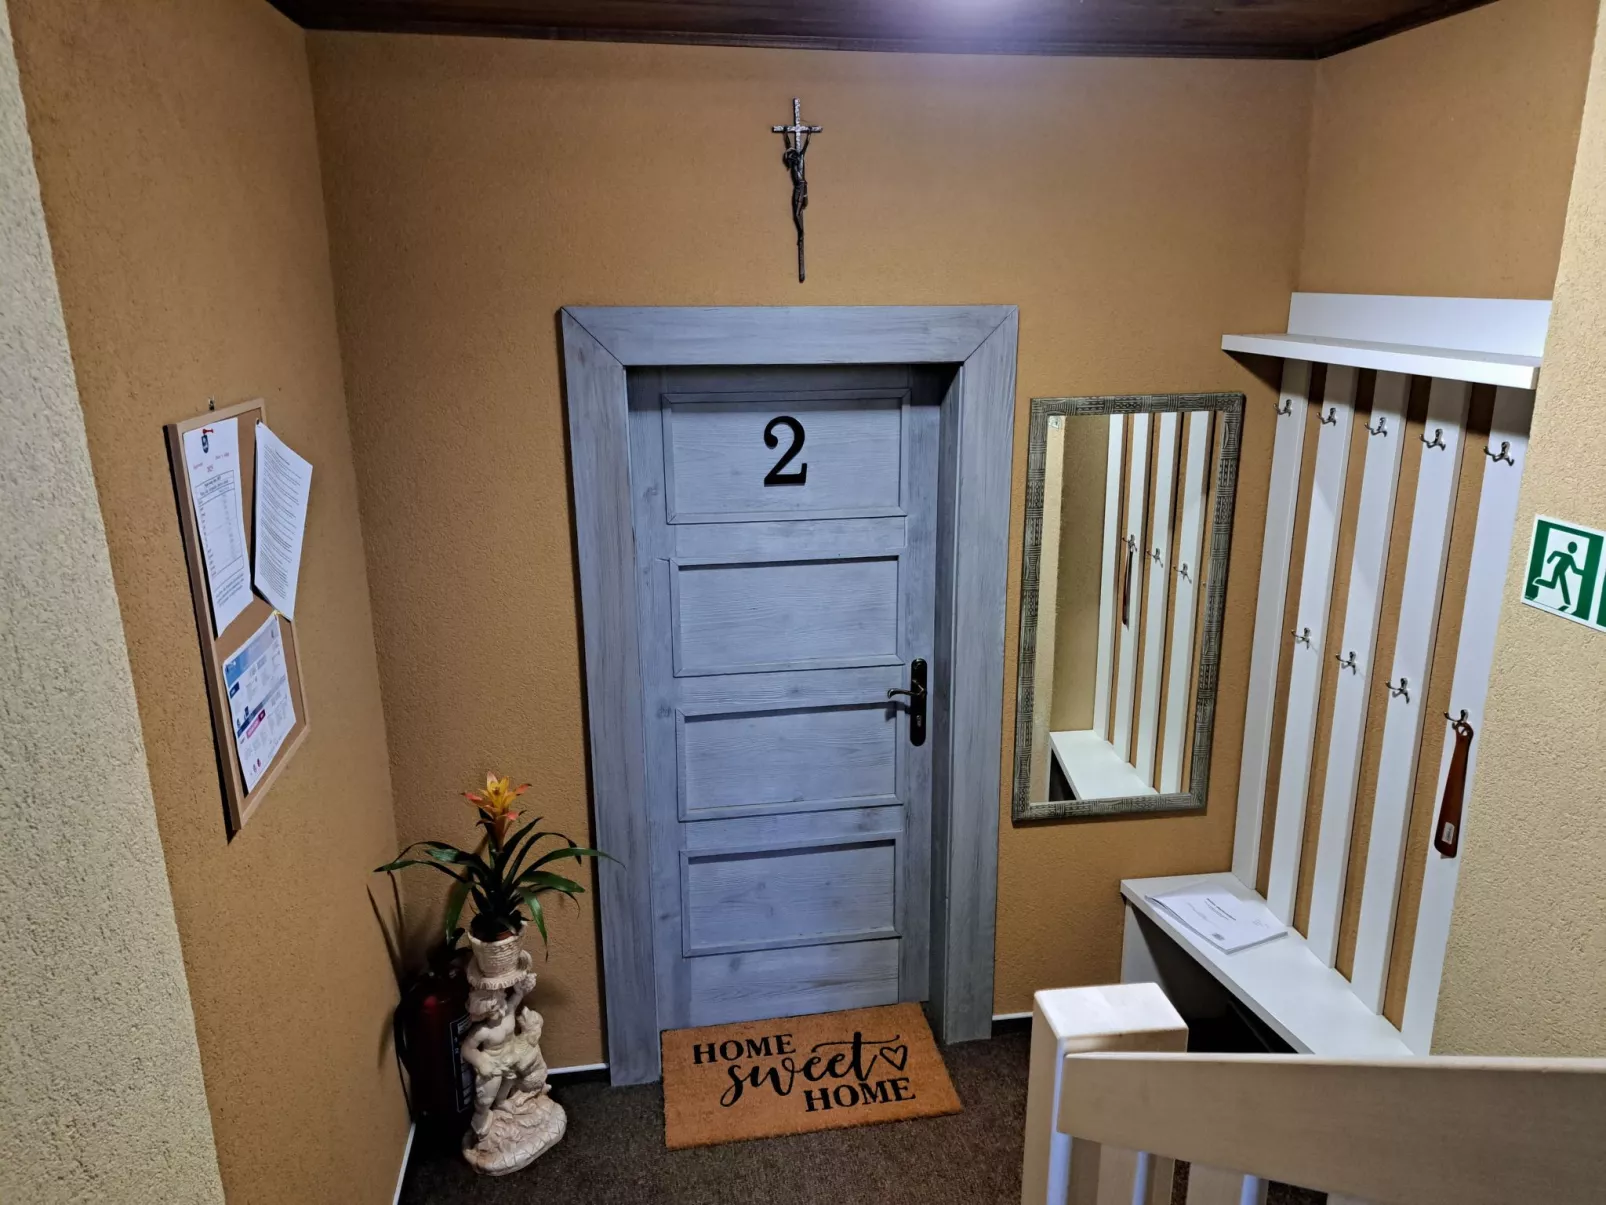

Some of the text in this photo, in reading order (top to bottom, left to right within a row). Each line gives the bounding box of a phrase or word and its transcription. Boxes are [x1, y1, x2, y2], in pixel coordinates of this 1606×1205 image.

[764, 415, 807, 487] 2
[693, 1033, 796, 1064] HOME
[720, 1031, 900, 1107] sweet
[804, 1077, 916, 1112] HOME
